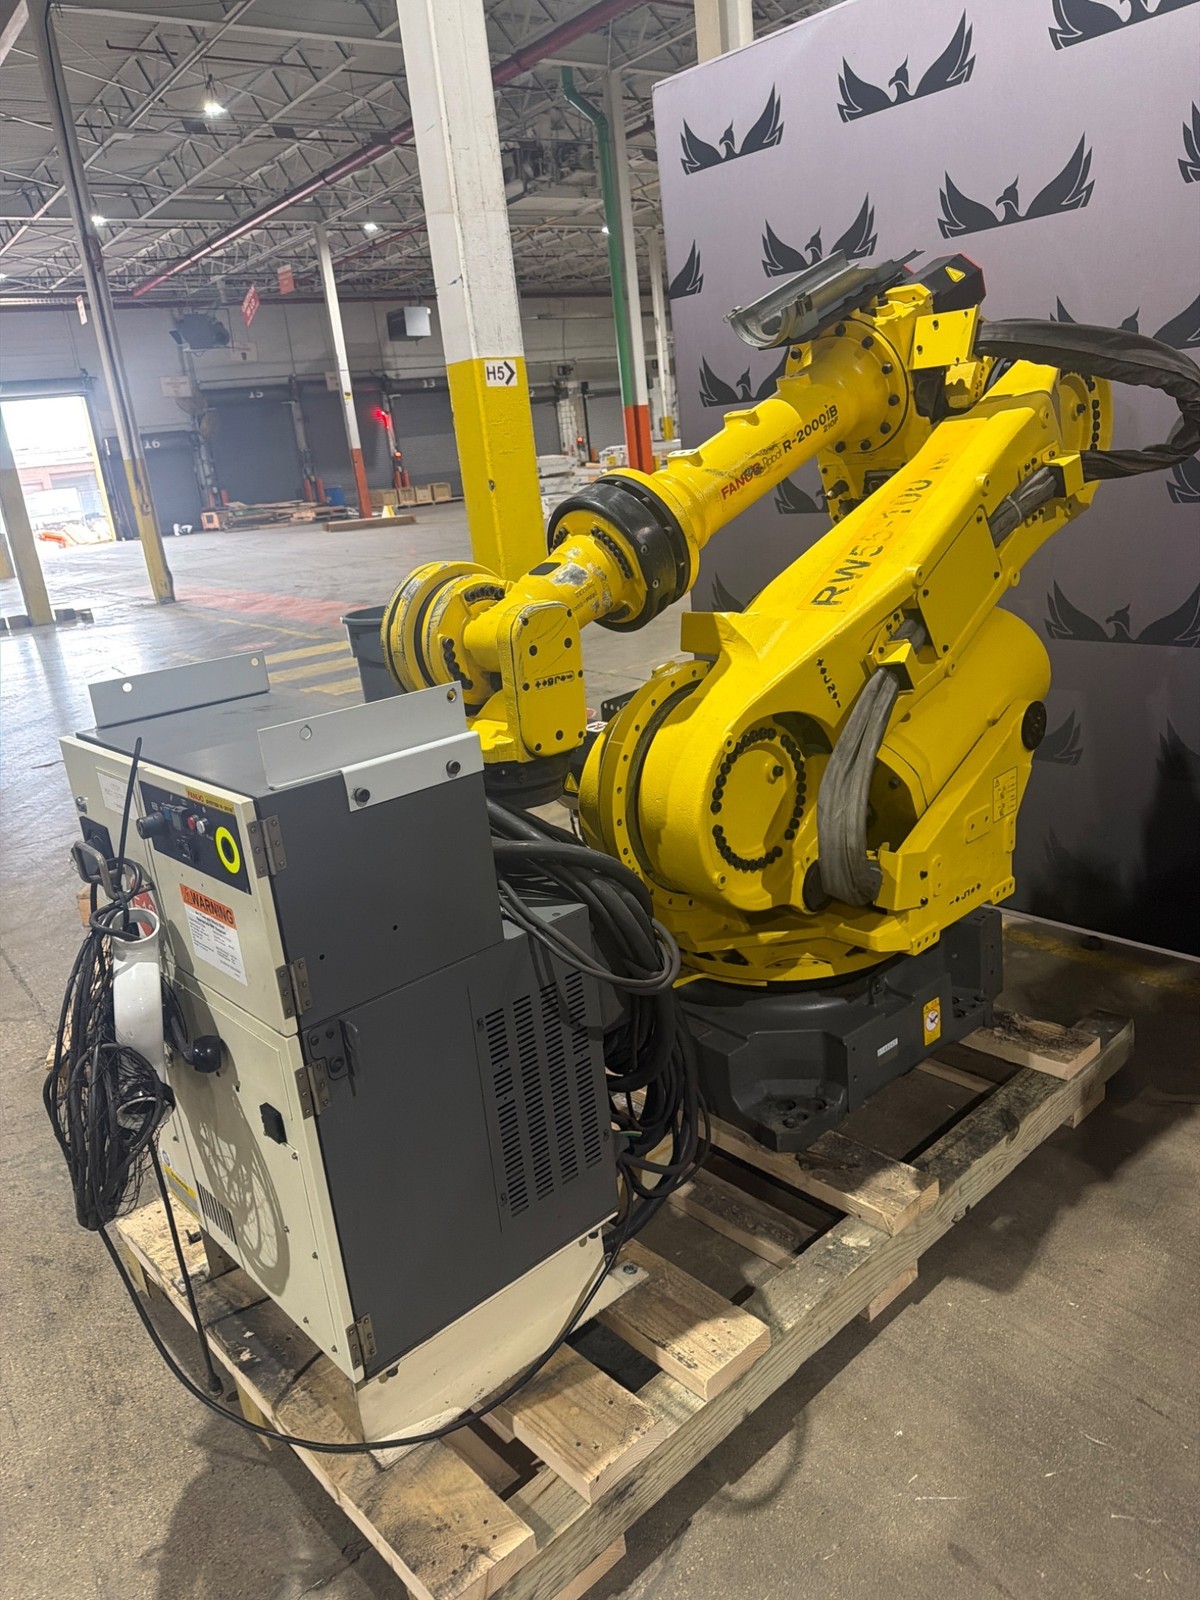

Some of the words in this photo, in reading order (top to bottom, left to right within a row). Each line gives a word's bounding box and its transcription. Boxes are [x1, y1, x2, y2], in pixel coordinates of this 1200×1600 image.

[486, 366, 505, 381] H5
[421, 378, 436, 389] 13
[823, 415, 839, 433] 210F
[145, 439, 160, 449] 16
[721, 462, 764, 500] FANUC
[761, 448, 783, 471] Robot
[782, 404, 839, 454] R-2000iB
[189, 890, 235, 925] WARNING
